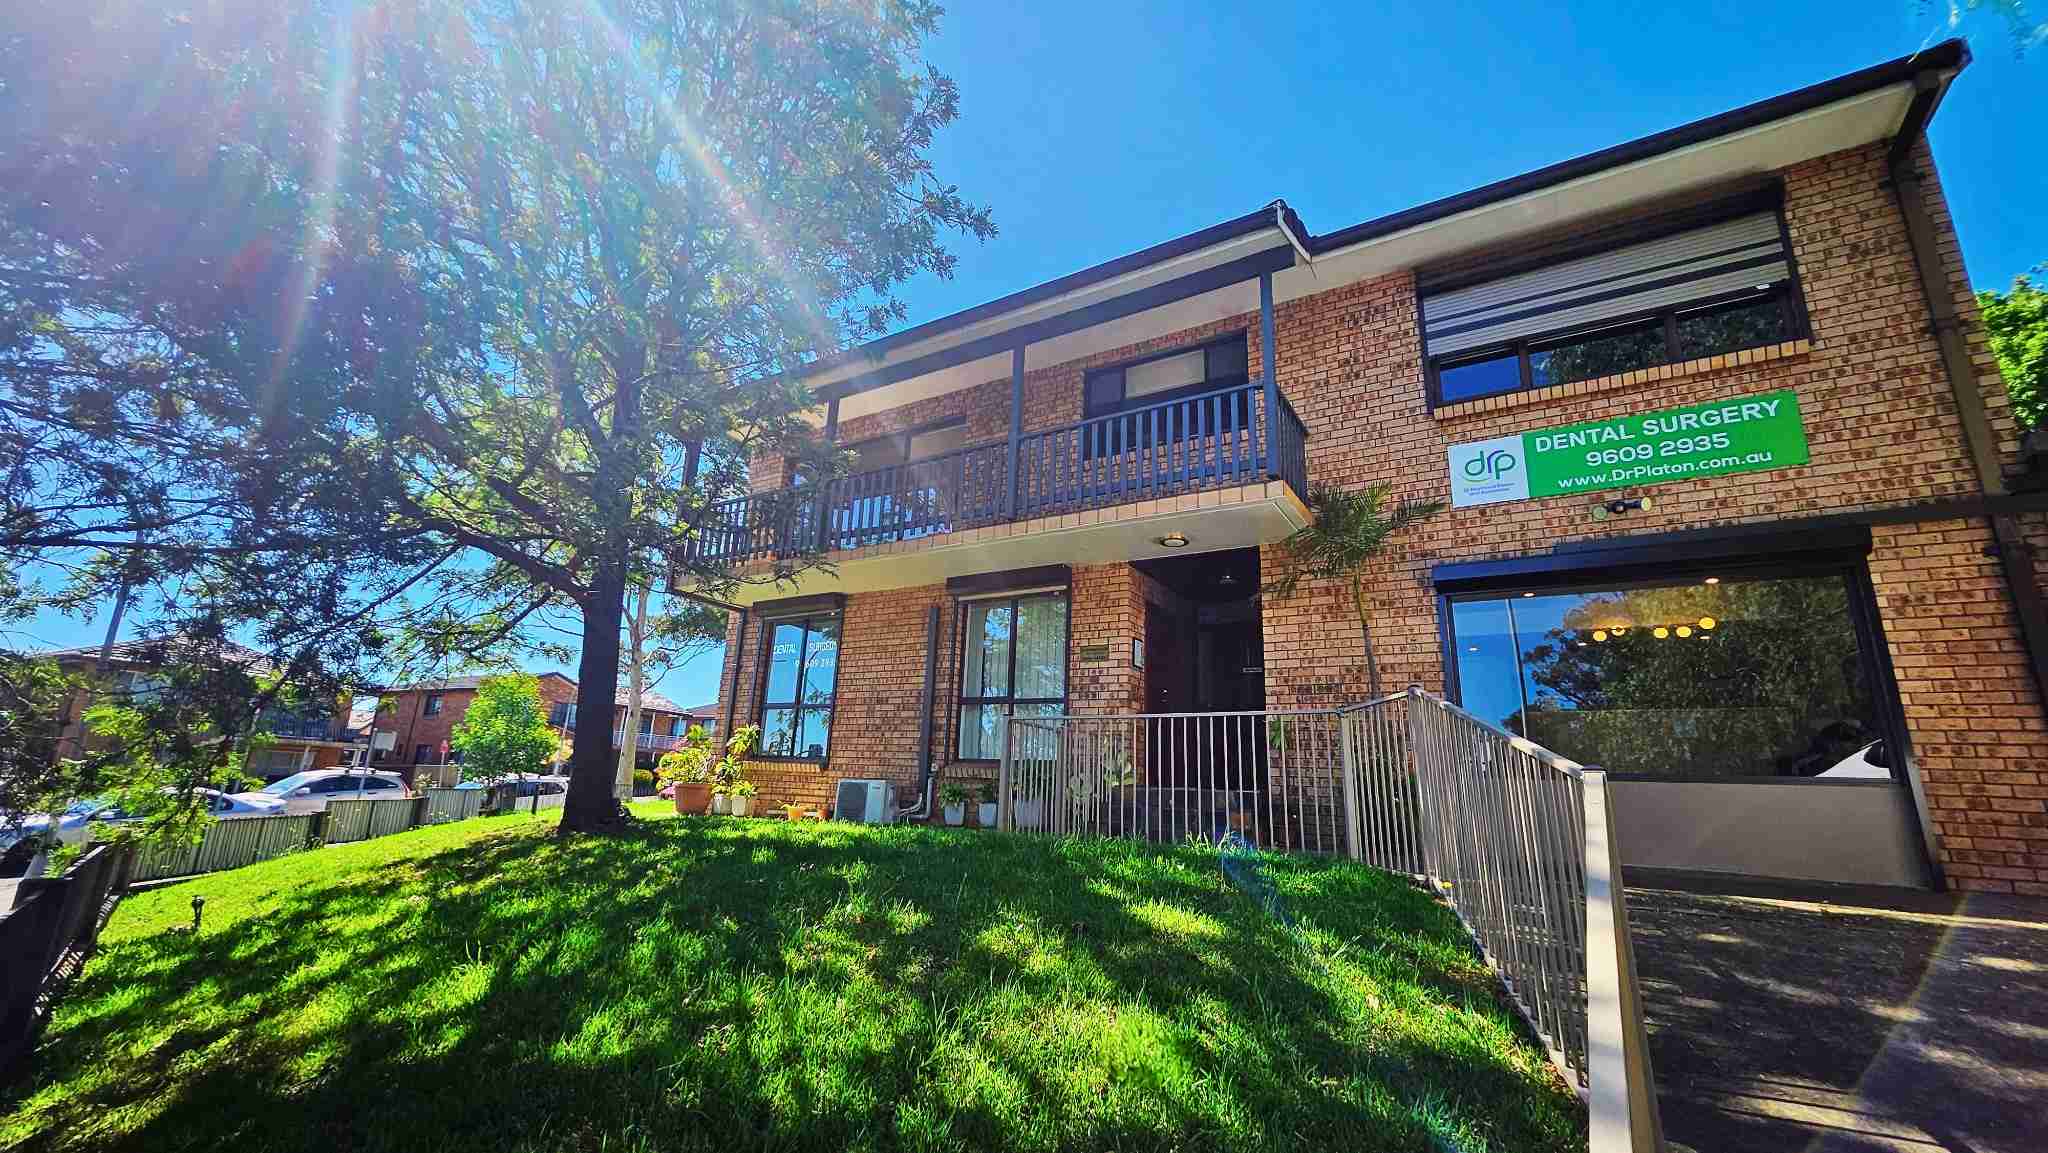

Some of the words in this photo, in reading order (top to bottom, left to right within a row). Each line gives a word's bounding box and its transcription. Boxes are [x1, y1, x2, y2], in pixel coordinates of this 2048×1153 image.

[1535, 424, 1636, 452] DENTAL
[1642, 399, 1780, 435] SURGERY
[1465, 449, 1516, 480] drp
[1585, 443, 1653, 466] 9609
[1659, 432, 1730, 457] 2935
[1558, 451, 1773, 488] www.DrPlaton.com.au
